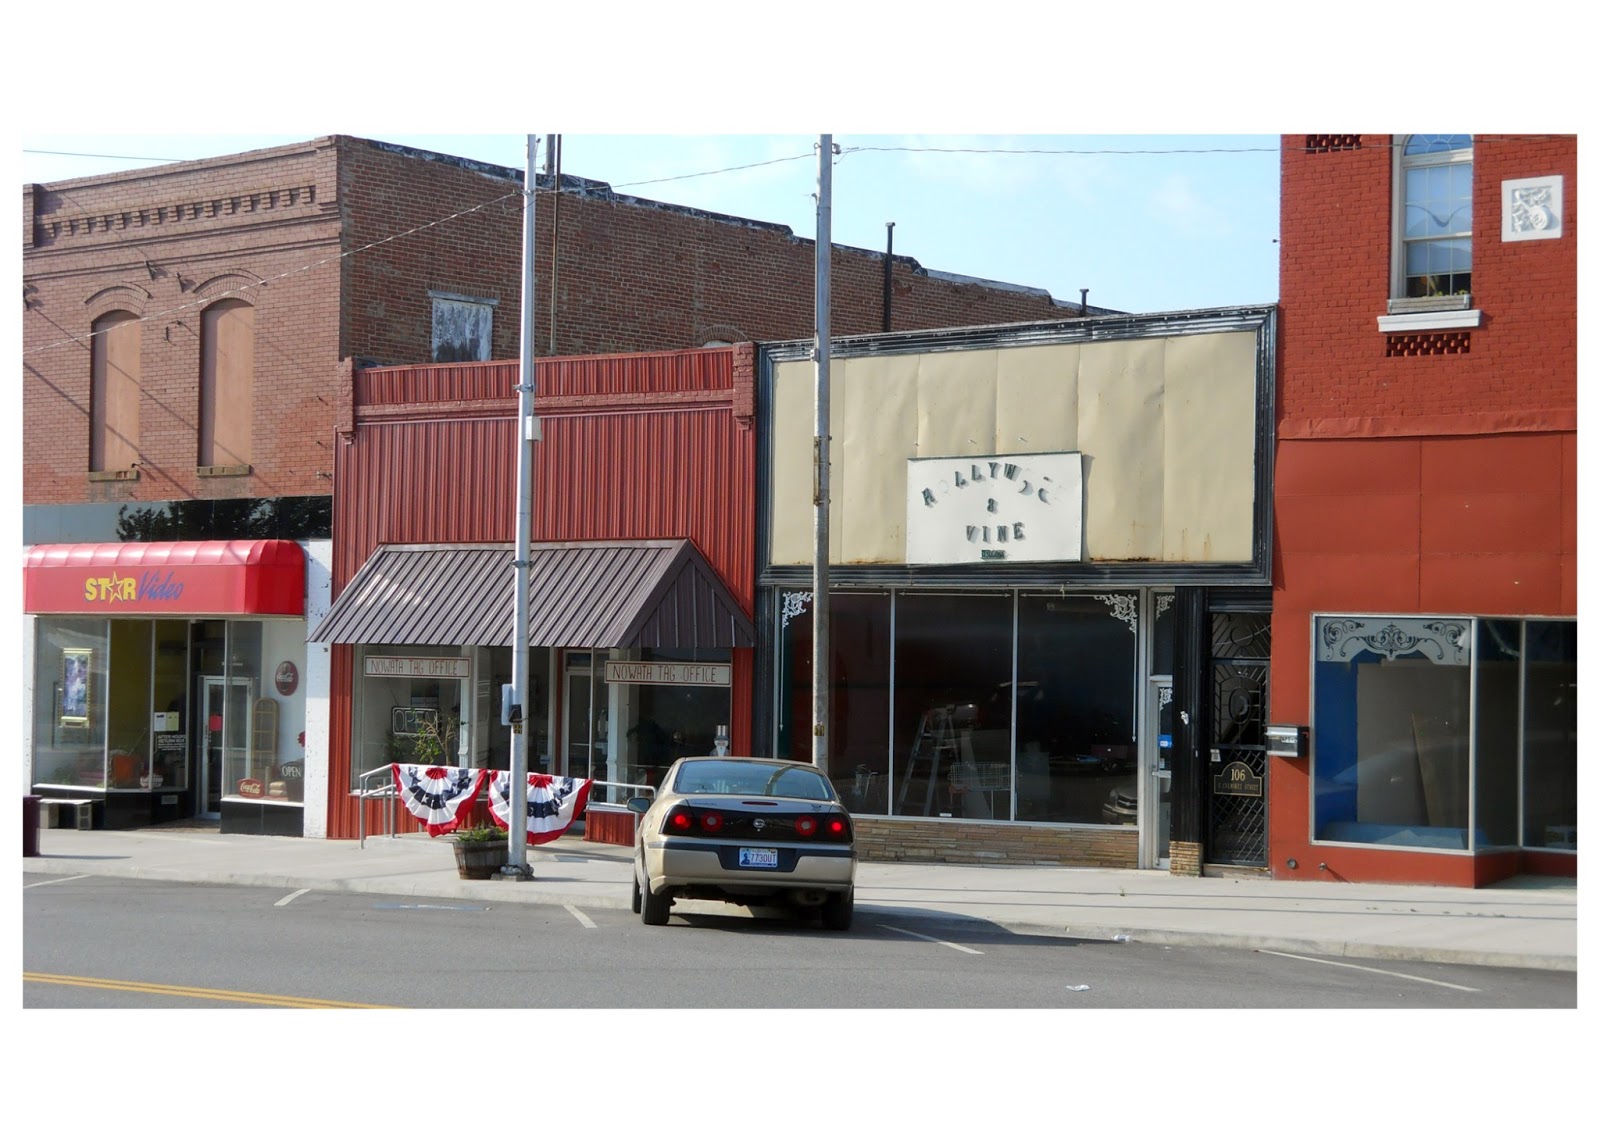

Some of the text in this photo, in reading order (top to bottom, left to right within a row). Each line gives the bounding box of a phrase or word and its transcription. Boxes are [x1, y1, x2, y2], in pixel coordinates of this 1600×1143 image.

[966, 522, 1025, 542] VINE
[137, 569, 184, 601] Video
[371, 659, 458, 676] NOWATA TAG OFFICE
[612, 664, 716, 682] NOWATA TAG OFFICE
[395, 709, 437, 733] OPEN
[281, 765, 302, 777] OPEN
[1231, 768, 1246, 781] 106
